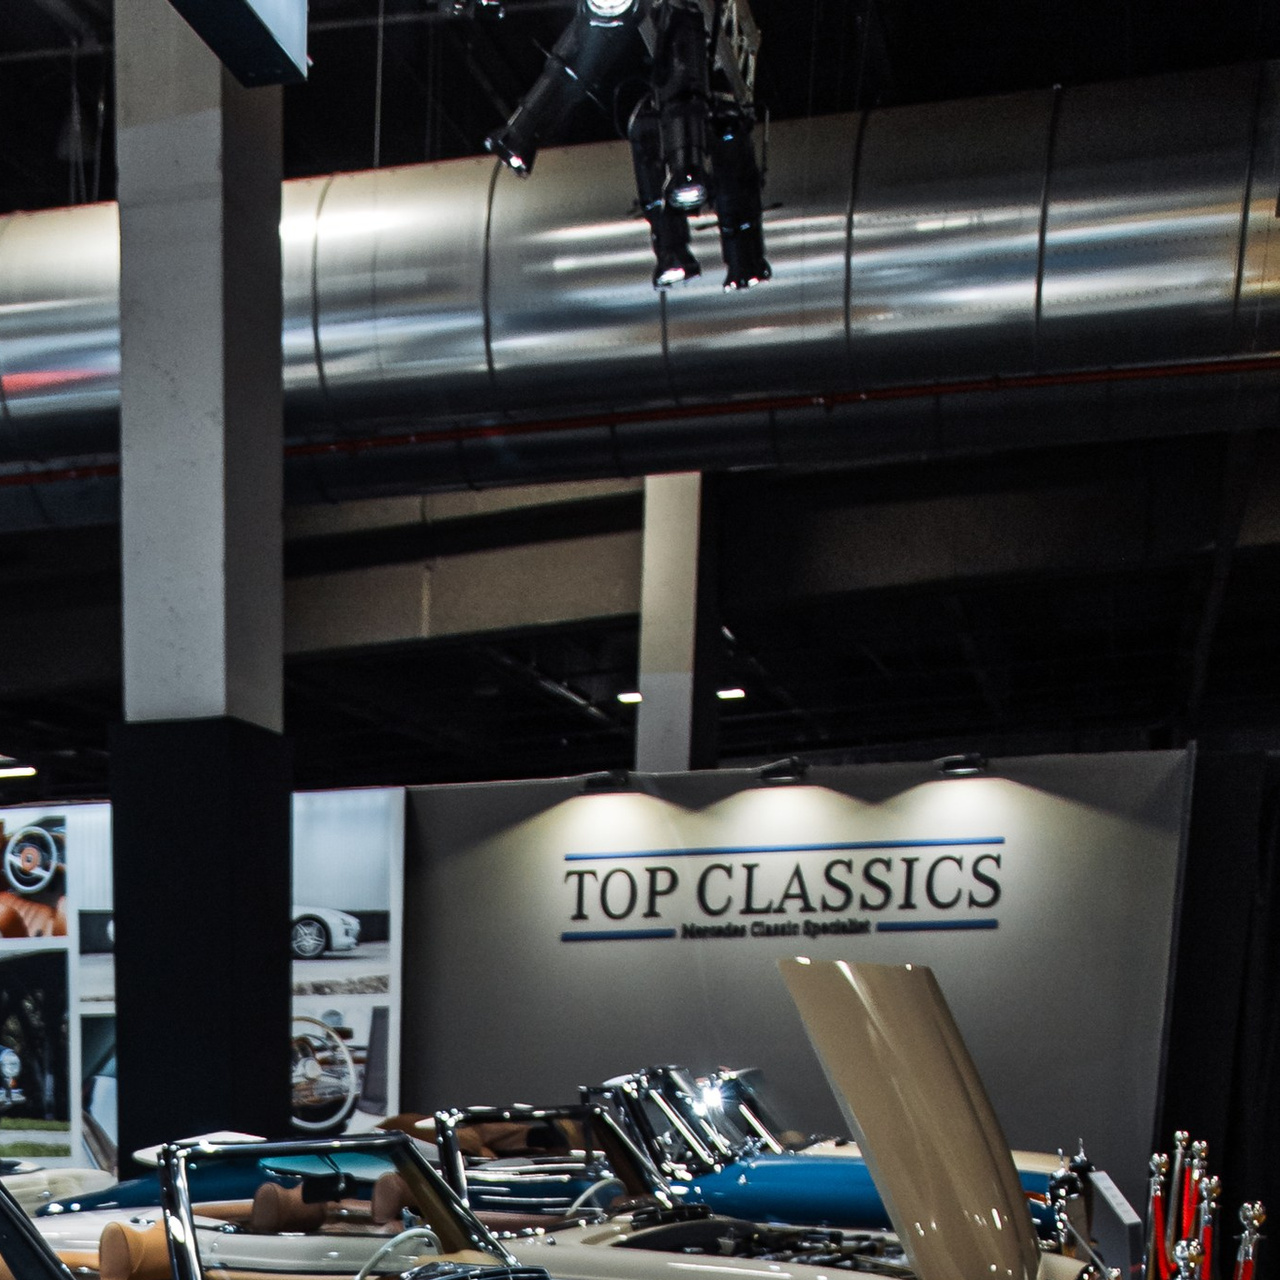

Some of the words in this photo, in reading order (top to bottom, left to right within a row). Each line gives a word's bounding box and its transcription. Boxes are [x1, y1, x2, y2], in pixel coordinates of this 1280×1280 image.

[564, 867, 679, 920] TOP
[696, 853, 1002, 917] CLASSICS
[681, 922, 747, 939] Mercedes
[751, 920, 800, 937] Classic
[802, 918, 870, 940] Specialist
